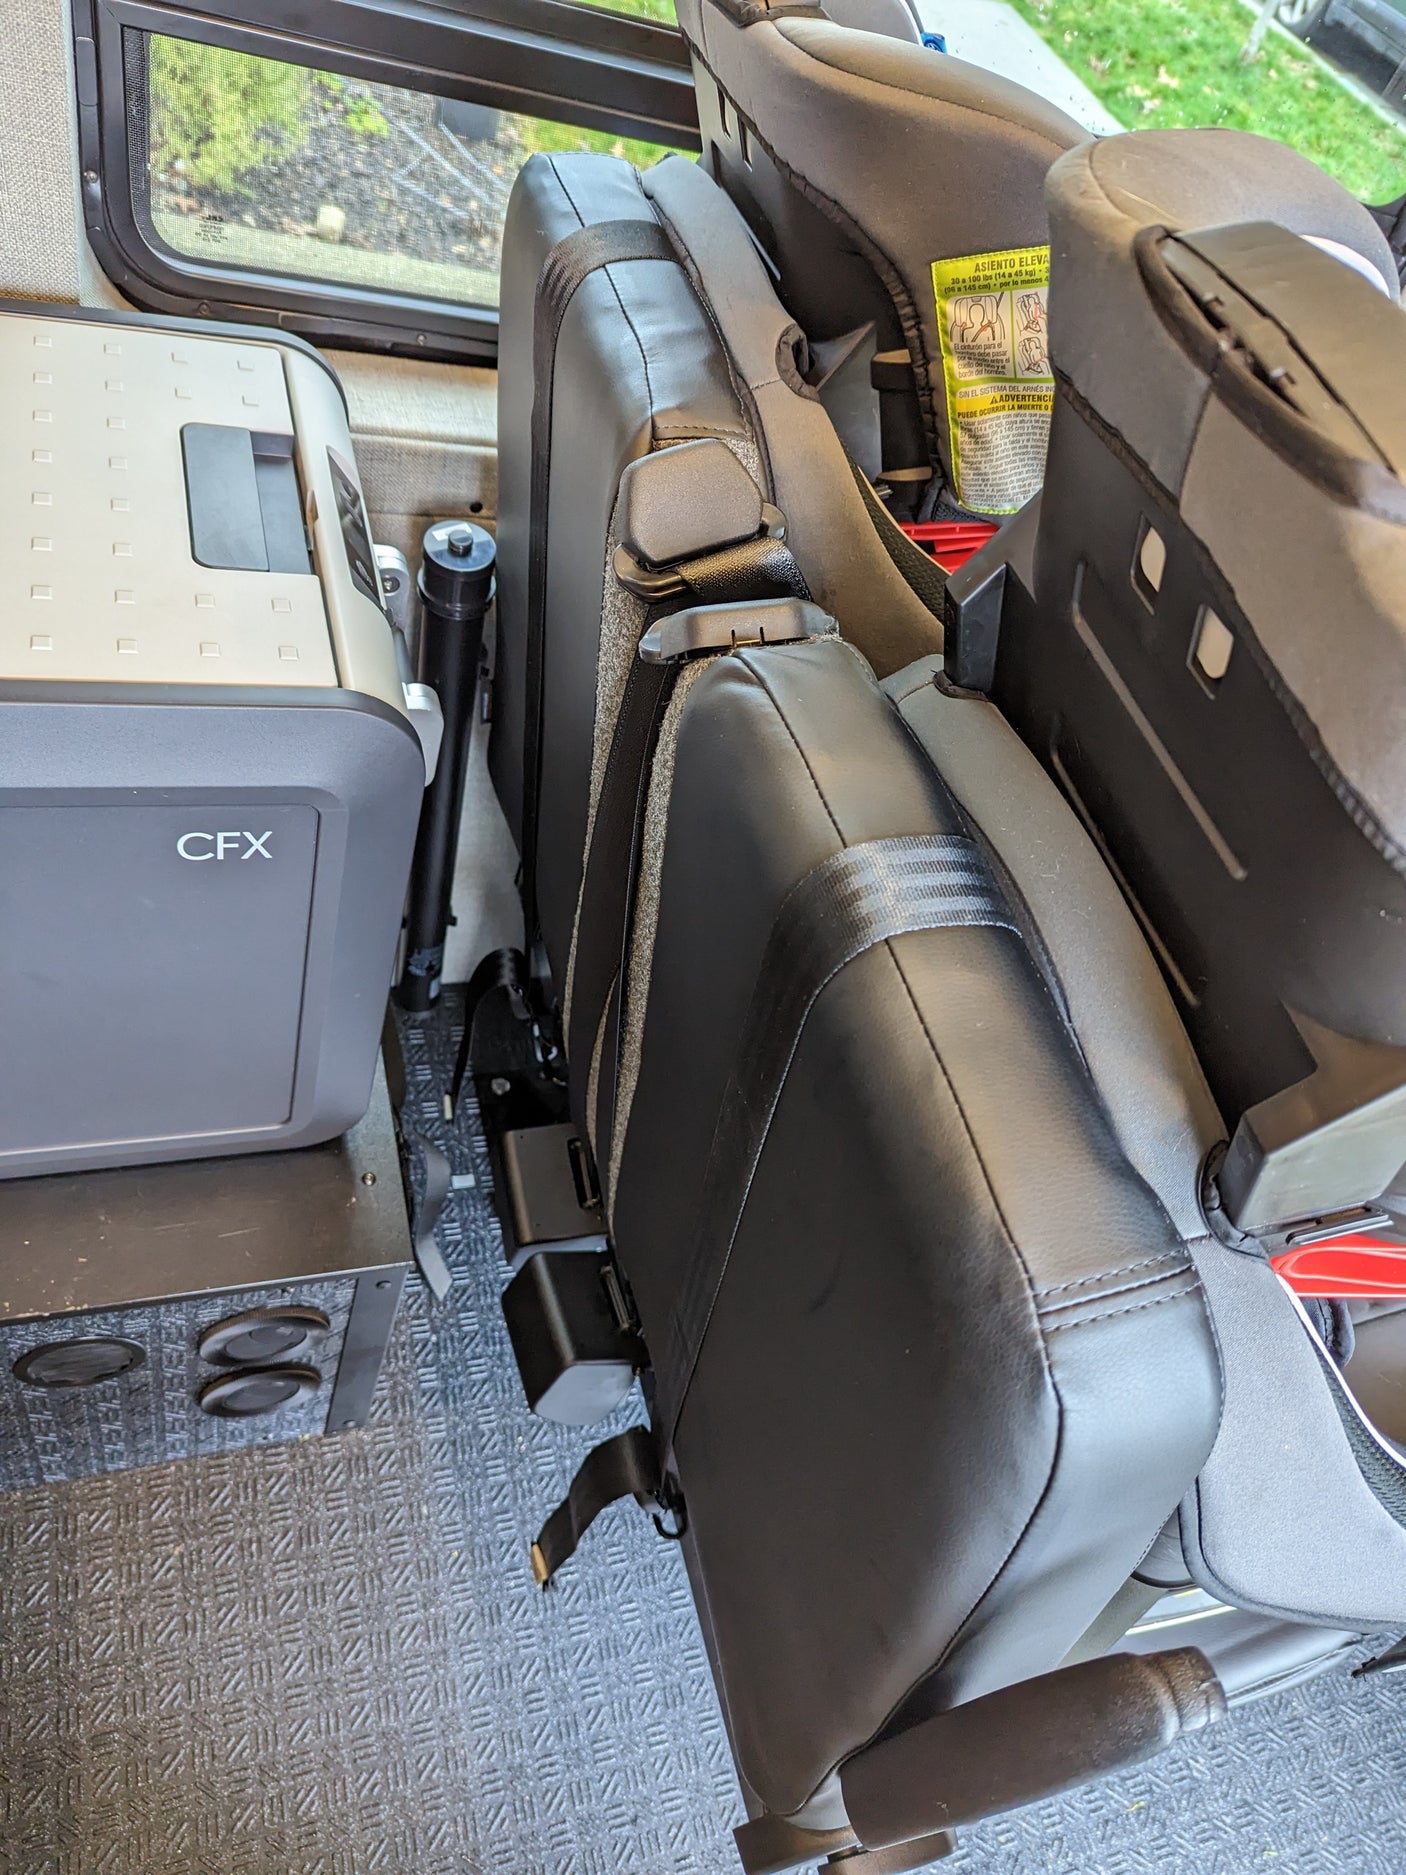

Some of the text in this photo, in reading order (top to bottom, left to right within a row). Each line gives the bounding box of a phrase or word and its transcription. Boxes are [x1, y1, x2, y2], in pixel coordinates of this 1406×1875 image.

[974, 258, 1016, 273] ASIENTO
[968, 275, 981, 283] 100
[995, 272, 1006, 281] (14
[1025, 268, 1036, 277] kg)
[1000, 280, 1010, 288] por
[1021, 277, 1043, 285] menos
[983, 343, 997, 352] para
[958, 390, 970, 398] SIN
[971, 389, 979, 397] EL
[980, 385, 1006, 395] SISTEMA
[1022, 384, 1044, 393] ARNÉS
[999, 393, 1054, 403] ADVERTENCI
[957, 409, 978, 419] PUEDE
[978, 405, 1006, 417] OCURRIR
[1017, 403, 1043, 411] MUERTE
[176, 831, 273, 861] CFX
